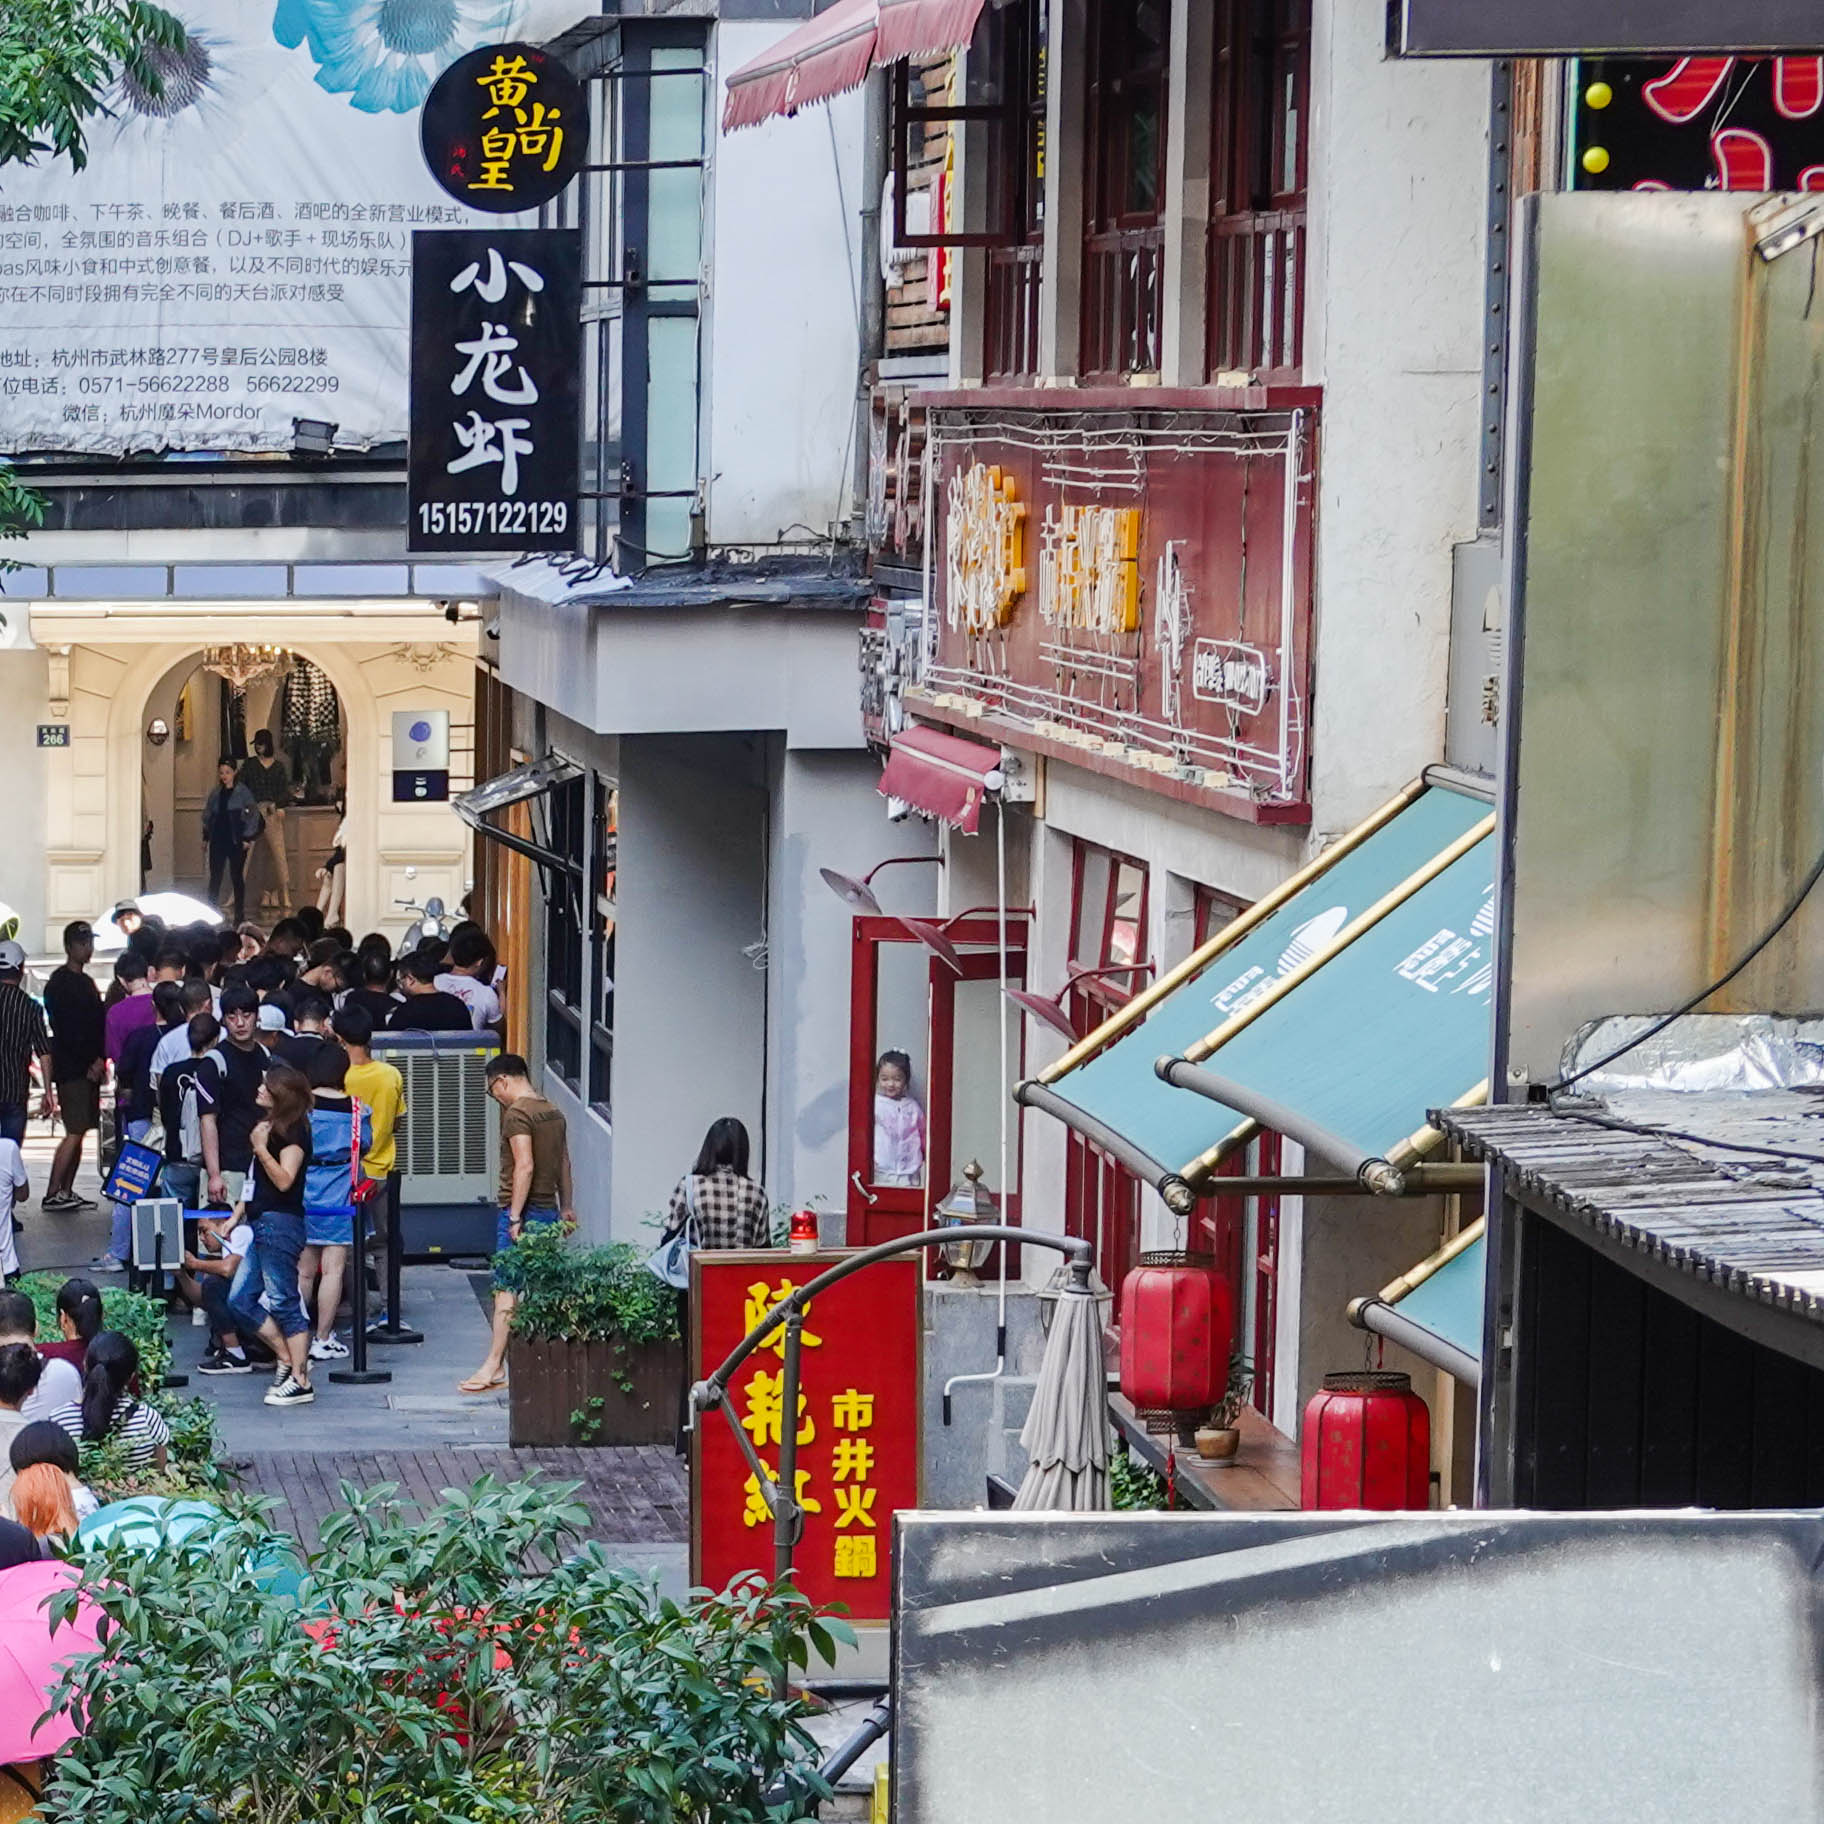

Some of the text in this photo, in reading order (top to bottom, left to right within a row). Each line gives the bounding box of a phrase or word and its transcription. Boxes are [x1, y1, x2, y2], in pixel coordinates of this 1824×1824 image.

[247, 375, 340, 393] 56622299
[447, 248, 544, 495] 小龙虾
[63, 402, 263, 423] 微信：杭州魔朵Mordor
[419, 501, 567, 534] 15157122129
[832, 1388, 877, 1578] 市井火鍋
